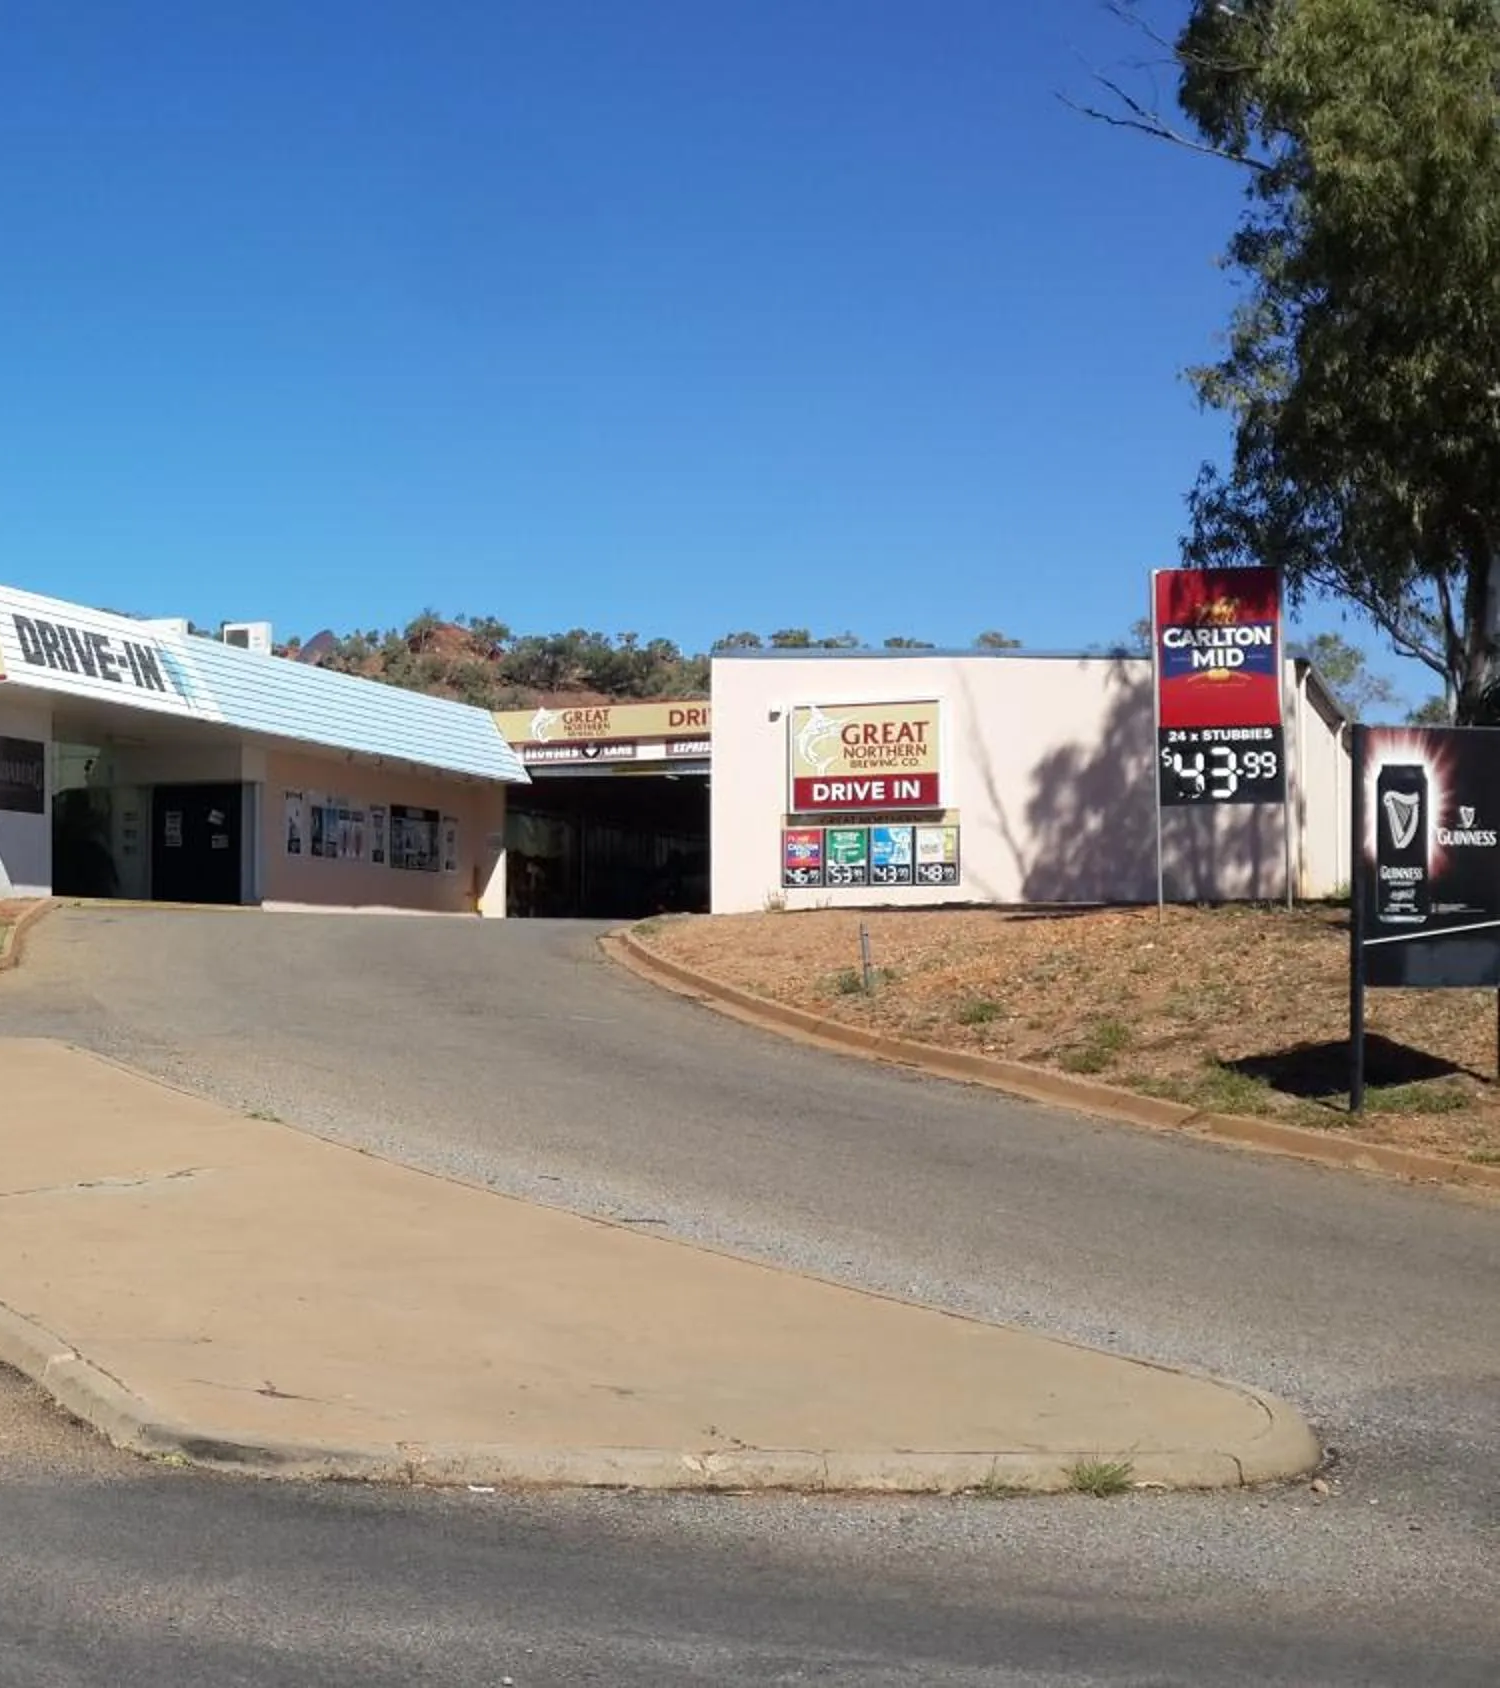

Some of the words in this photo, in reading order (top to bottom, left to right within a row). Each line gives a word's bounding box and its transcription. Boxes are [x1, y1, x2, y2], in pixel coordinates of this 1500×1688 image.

[1163, 626, 1272, 648] CARLTON
[12, 613, 166, 692] DRIVE-IN
[1192, 647, 1245, 668] MID
[562, 709, 611, 724] GREAT
[669, 708, 711, 727] DRI
[841, 721, 929, 745] GREAT
[1168, 730, 1187, 742] 24
[1202, 728, 1273, 741] STUBBIES
[843, 744, 928, 760] NORTHERN
[850, 758, 897, 769] BREWING
[812, 781, 885, 801] DRIVE
[894, 780, 921, 799] IN
[1437, 827, 1497, 846] GUINNESS
[1380, 865, 1423, 881] GUINNESS
